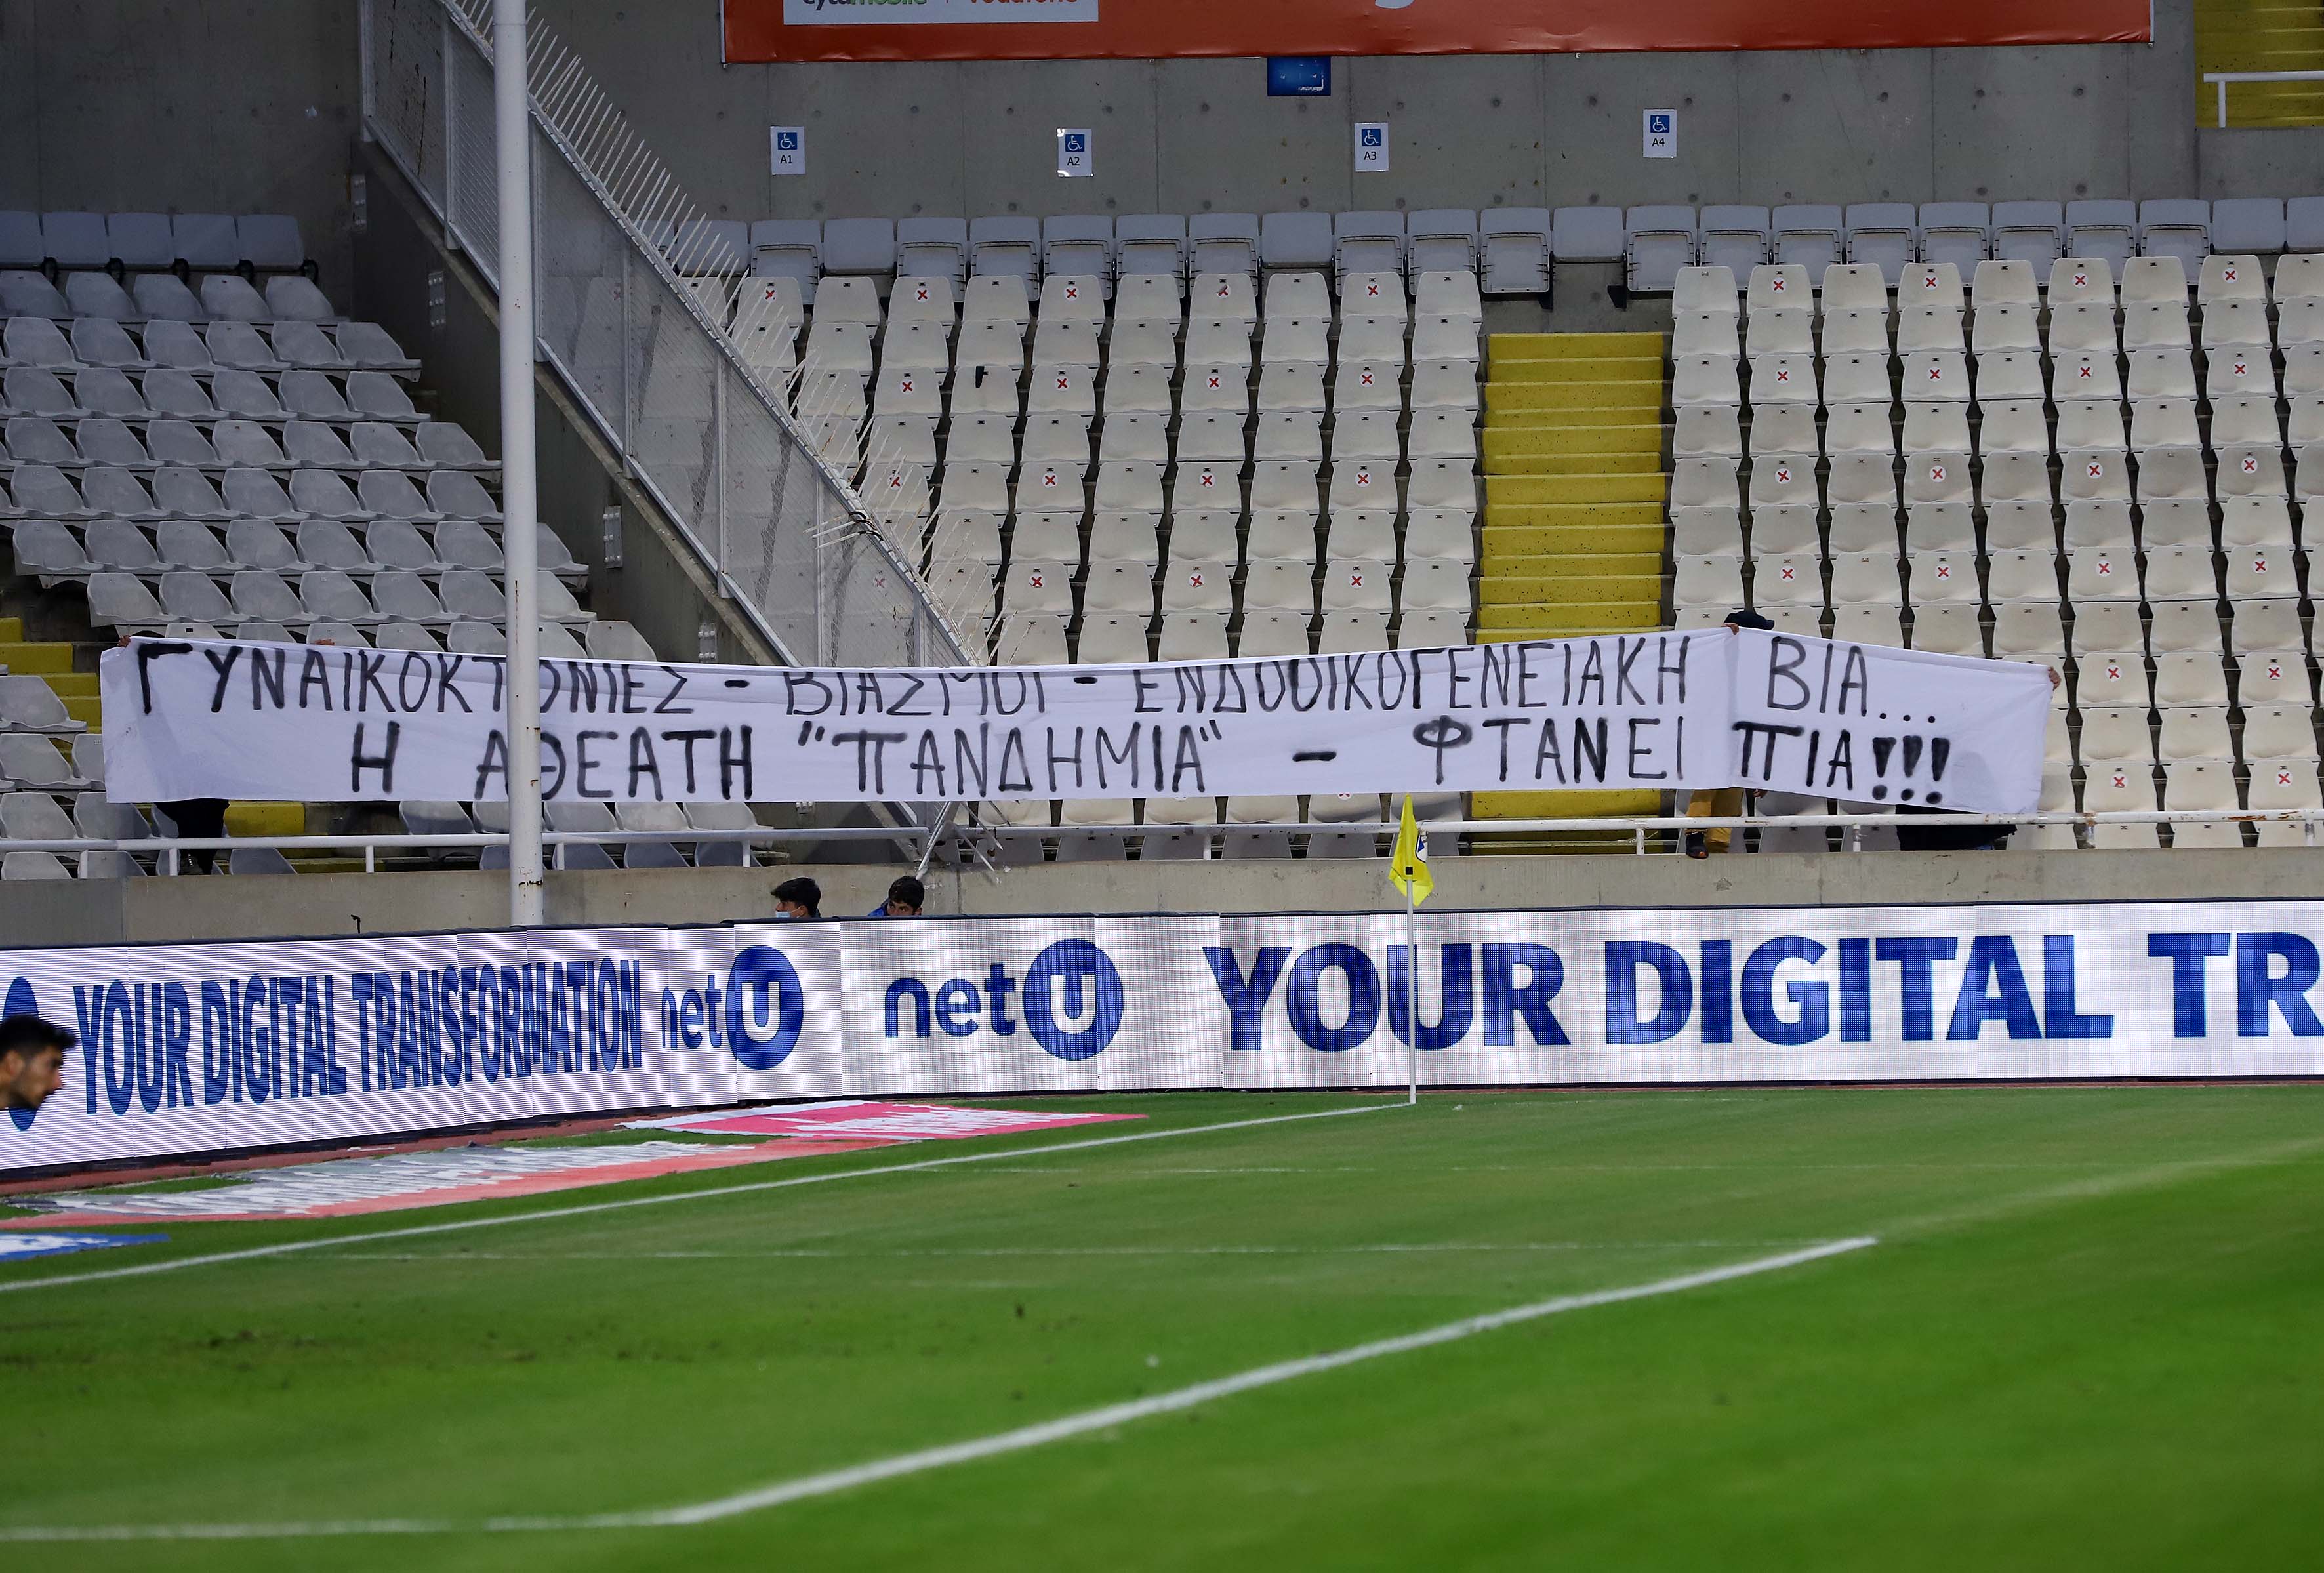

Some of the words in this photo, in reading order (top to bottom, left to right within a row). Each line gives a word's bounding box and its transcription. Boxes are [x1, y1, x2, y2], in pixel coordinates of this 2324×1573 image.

[1651, 137, 1665, 147] A4
[779, 154, 793, 164] A1
[1067, 156, 1080, 166] A2
[1364, 150, 1377, 161] A3
[351, 720, 401, 794] Η
[1412, 714, 1684, 786] ΦΤΑΝΕΙ
[1202, 942, 1572, 1053] YOUR
[1604, 934, 2115, 1046] DIGITAL
[2148, 931, 2324, 1038] TR
[73, 979, 195, 1117] YOUR
[201, 973, 348, 1106] DIGITAL
[352, 955, 643, 1092] TRANSFORMATION
